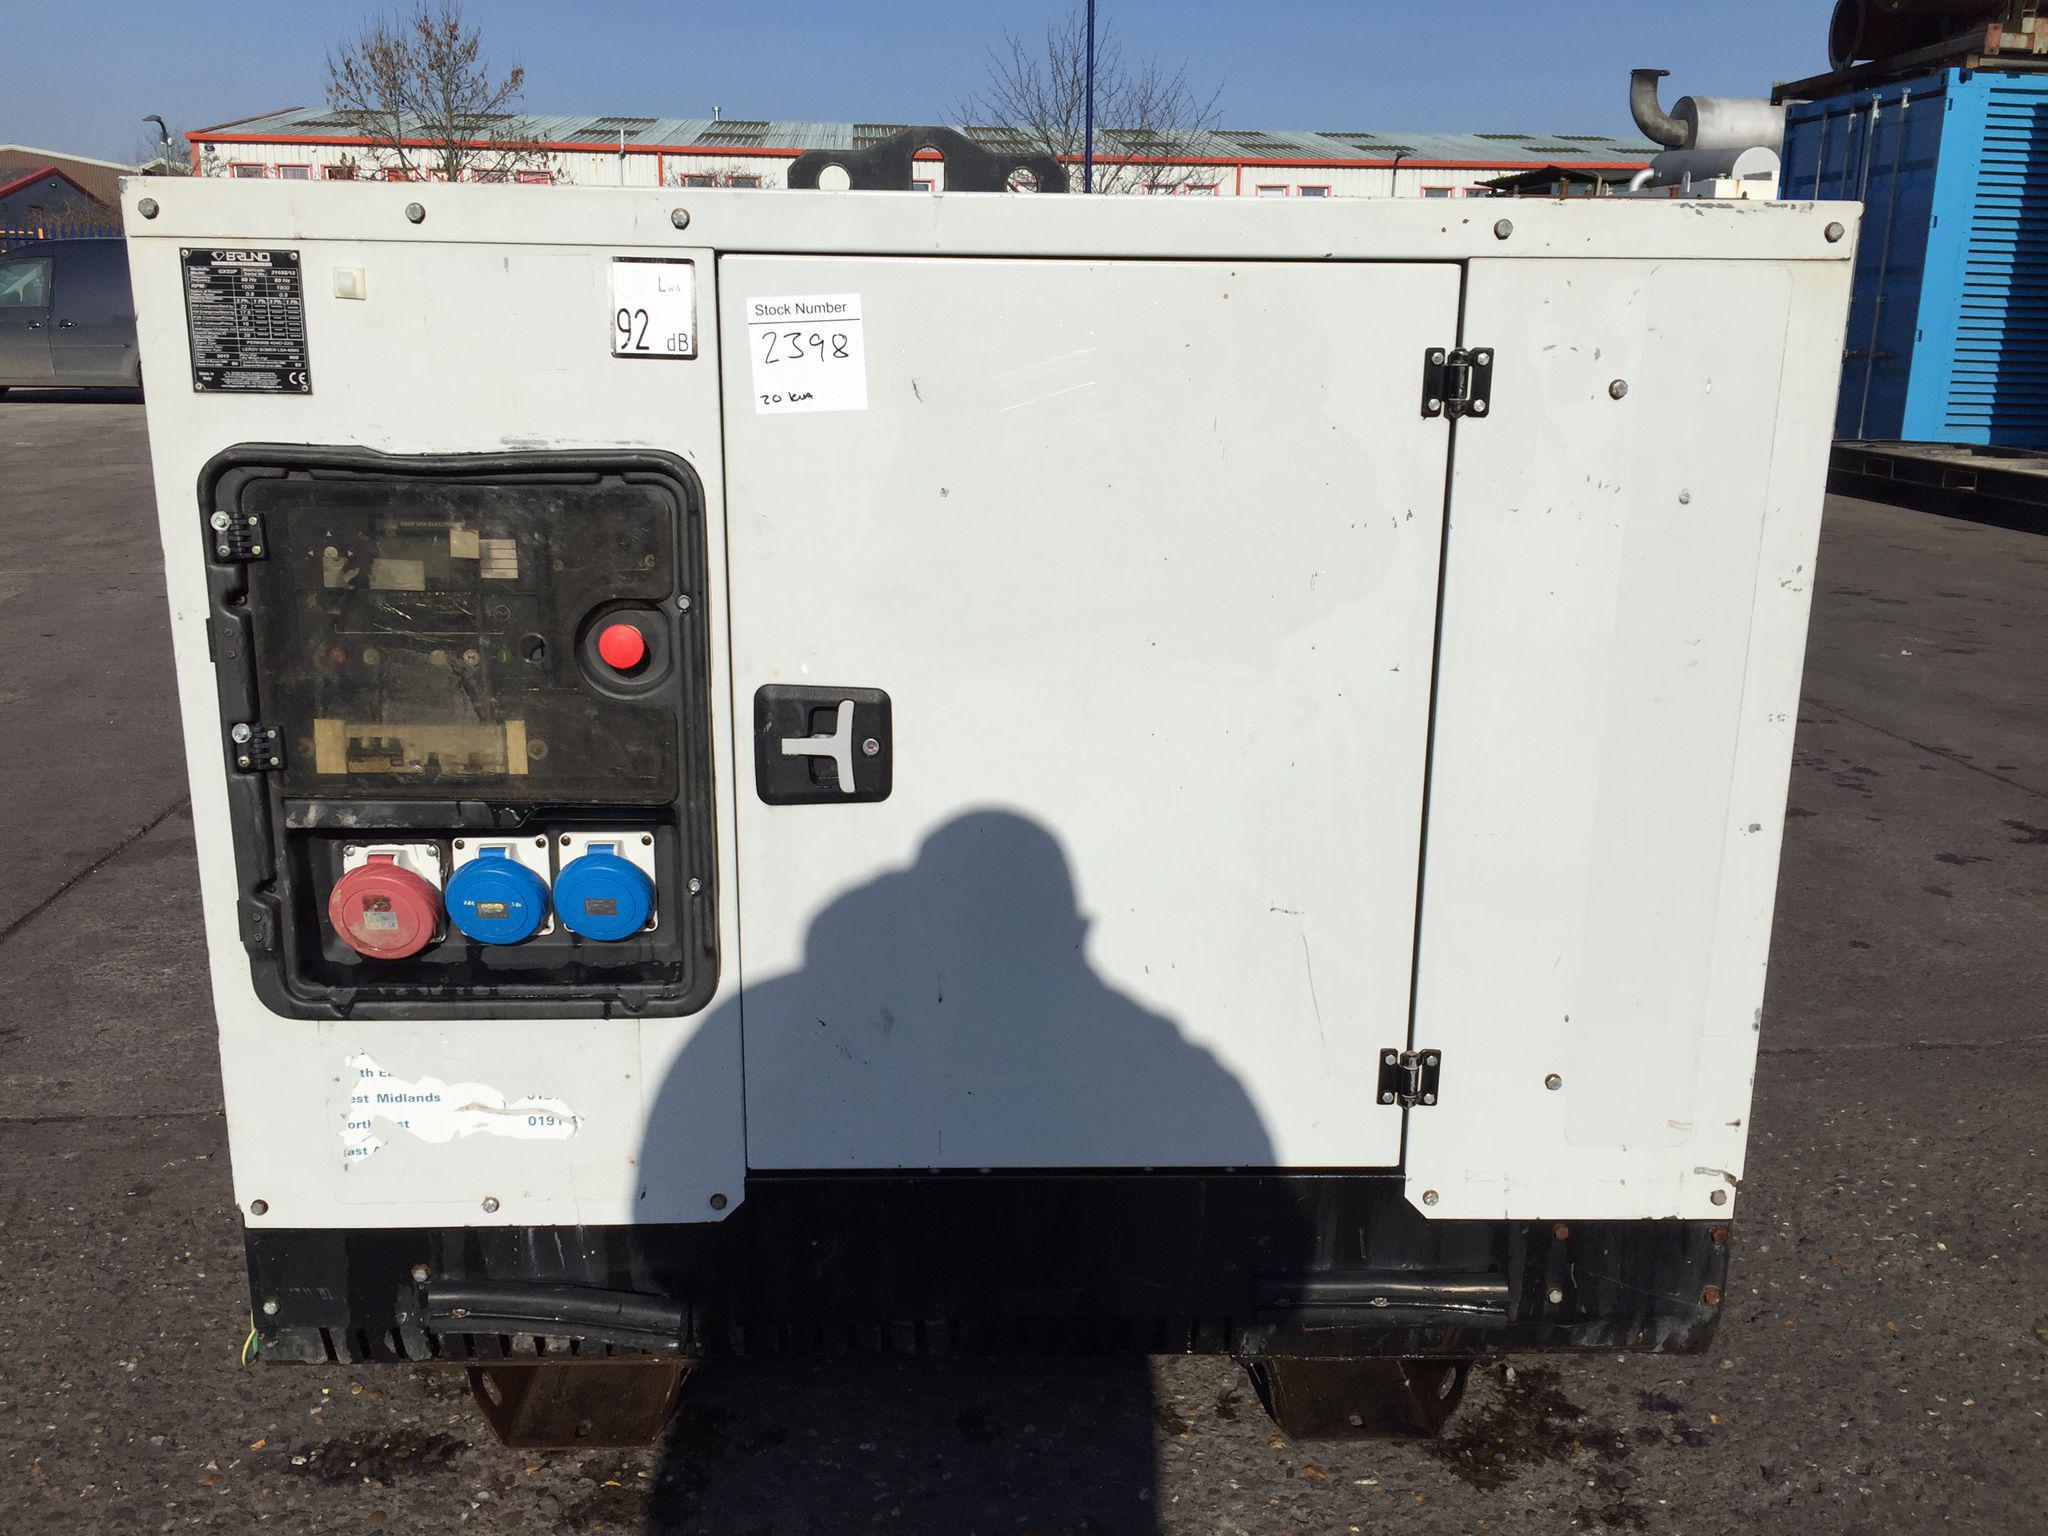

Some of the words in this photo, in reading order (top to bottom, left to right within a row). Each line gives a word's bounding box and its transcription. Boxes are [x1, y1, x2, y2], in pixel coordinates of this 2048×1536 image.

[226, 252, 270, 261] BRUNO
[754, 303, 791, 317] Stock
[795, 302, 848, 315] Number
[616, 307, 650, 350] 92
[667, 332, 689, 352] dB
[761, 331, 850, 364] 2398
[351, 1094, 370, 1104] est
[376, 1092, 442, 1103] Midlands
